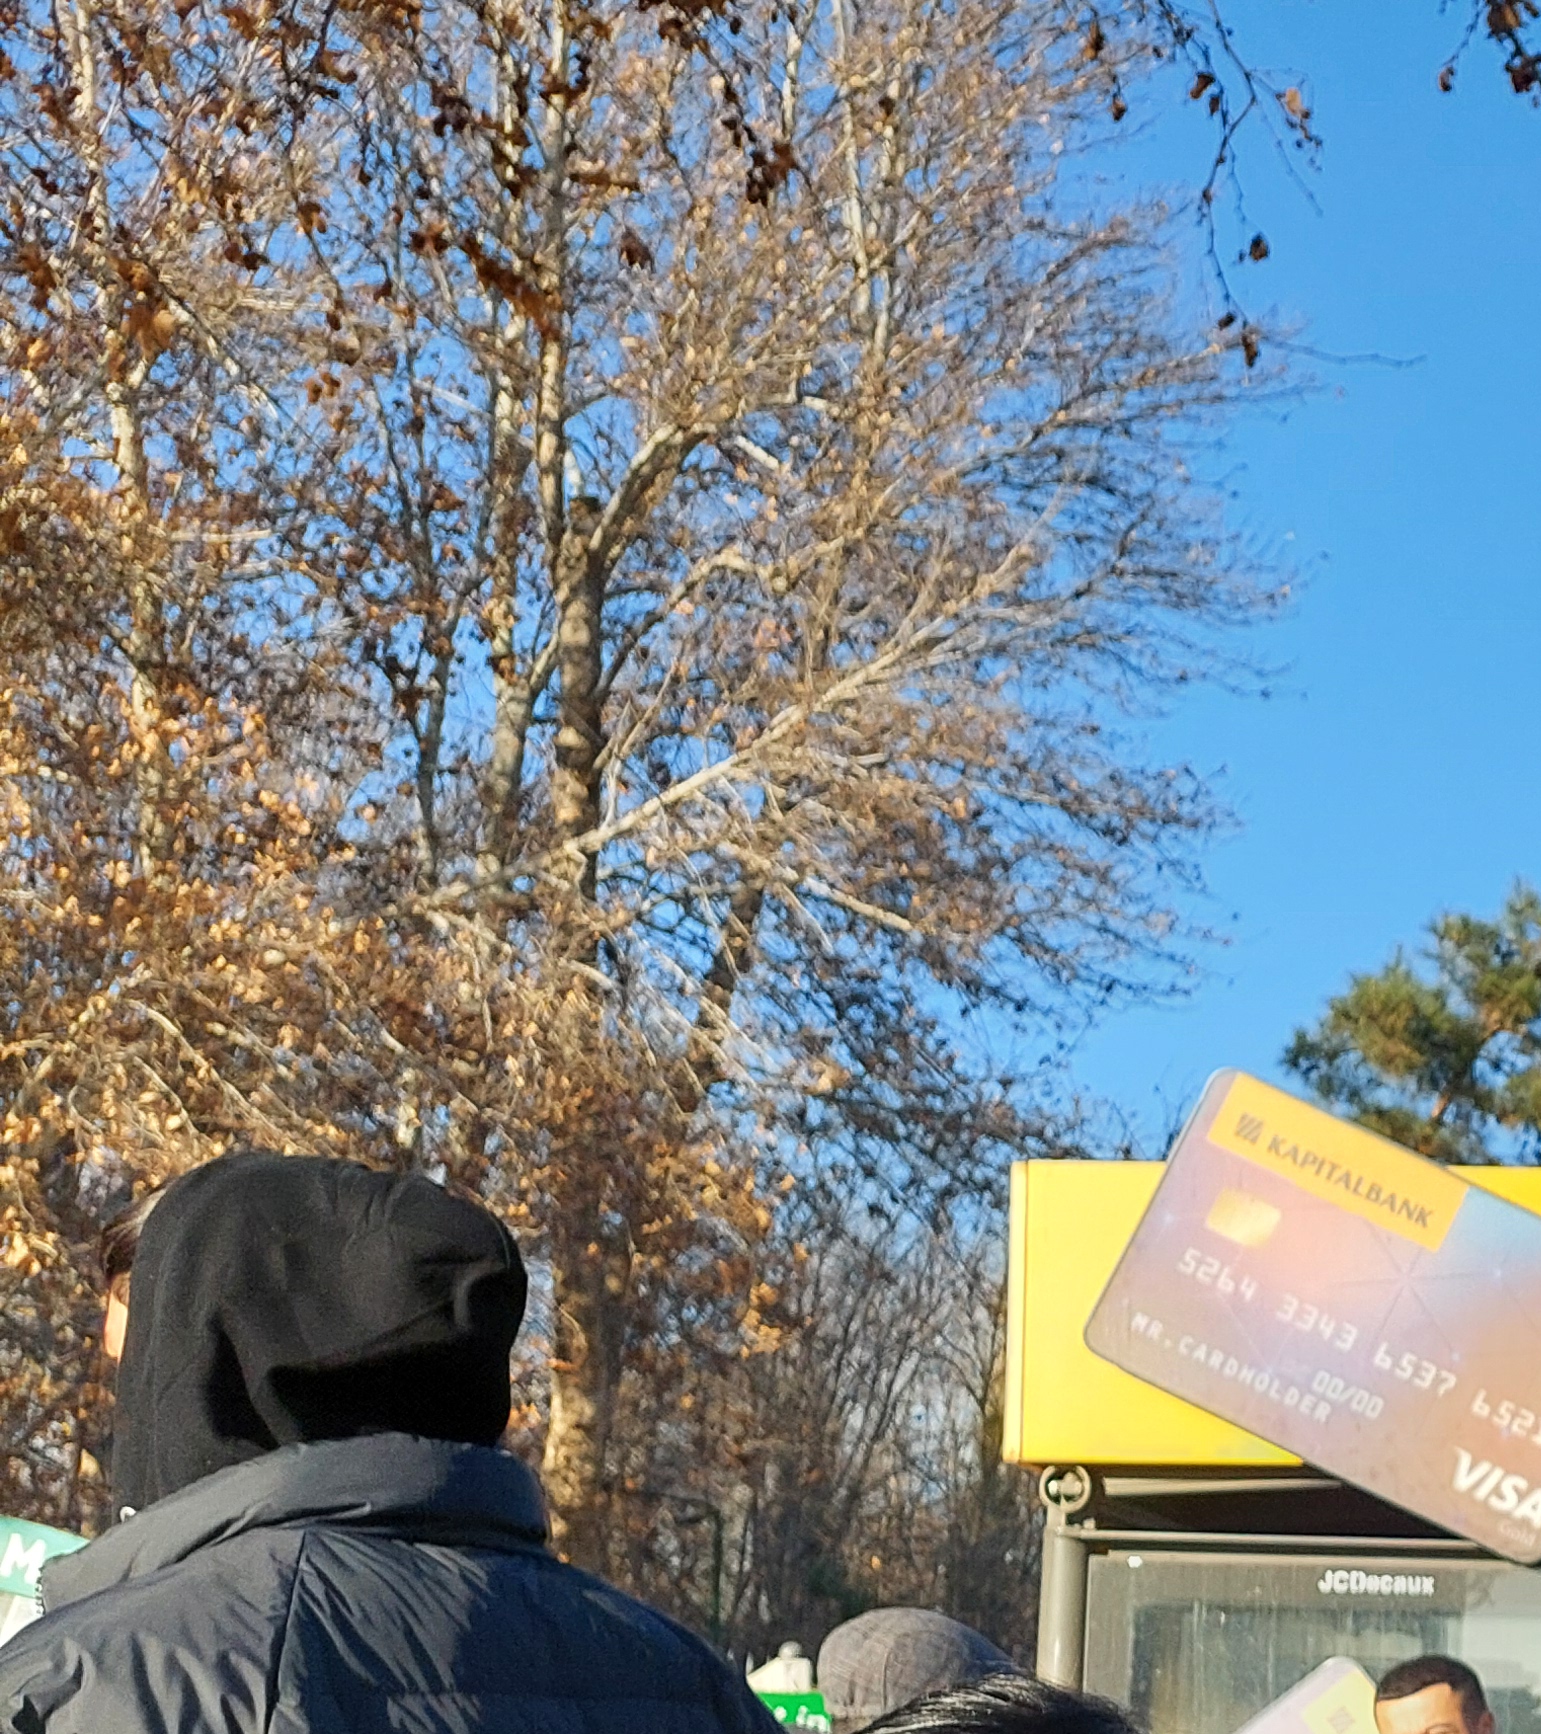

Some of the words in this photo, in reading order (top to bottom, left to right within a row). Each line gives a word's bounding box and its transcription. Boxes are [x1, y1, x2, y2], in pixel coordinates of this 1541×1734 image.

[1266, 1132, 1435, 1229] KAPITALBANK
[1177, 1246, 1258, 1301] 5264
[1275, 1293, 1359, 1354] 3343
[1373, 1341, 1458, 1398] 6537
[1317, 1569, 1435, 1598] JCDecaux
